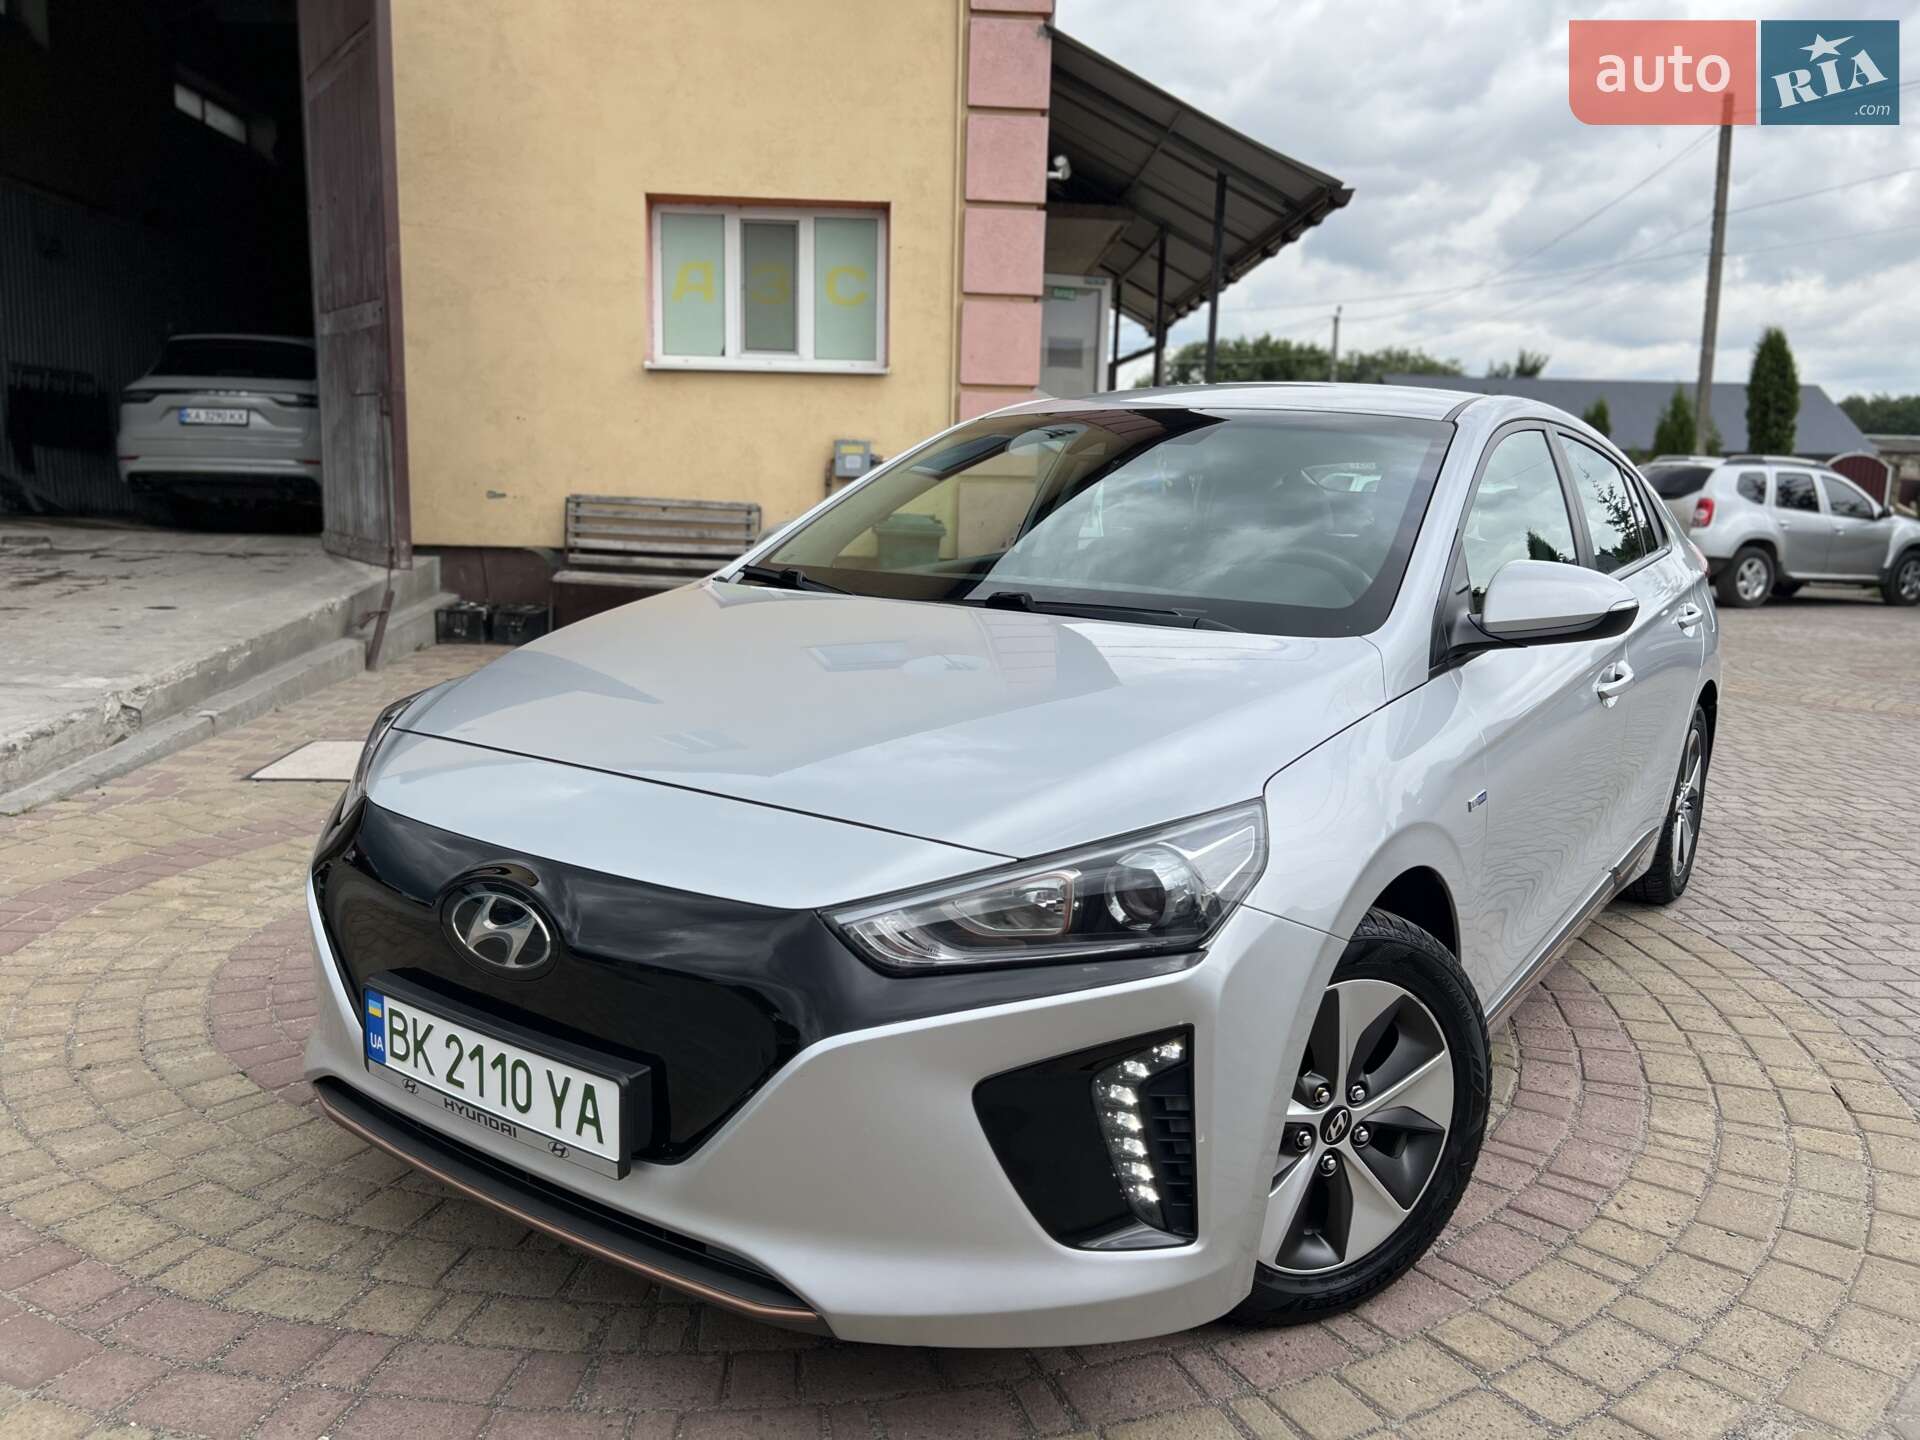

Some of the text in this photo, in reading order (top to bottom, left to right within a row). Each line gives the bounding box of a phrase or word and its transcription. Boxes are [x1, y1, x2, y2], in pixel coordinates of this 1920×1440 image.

[369, 1031, 385, 1052] UA
[388, 1007, 604, 1145] BK 2110 YA
[443, 1097, 518, 1139] HYUNDAI
